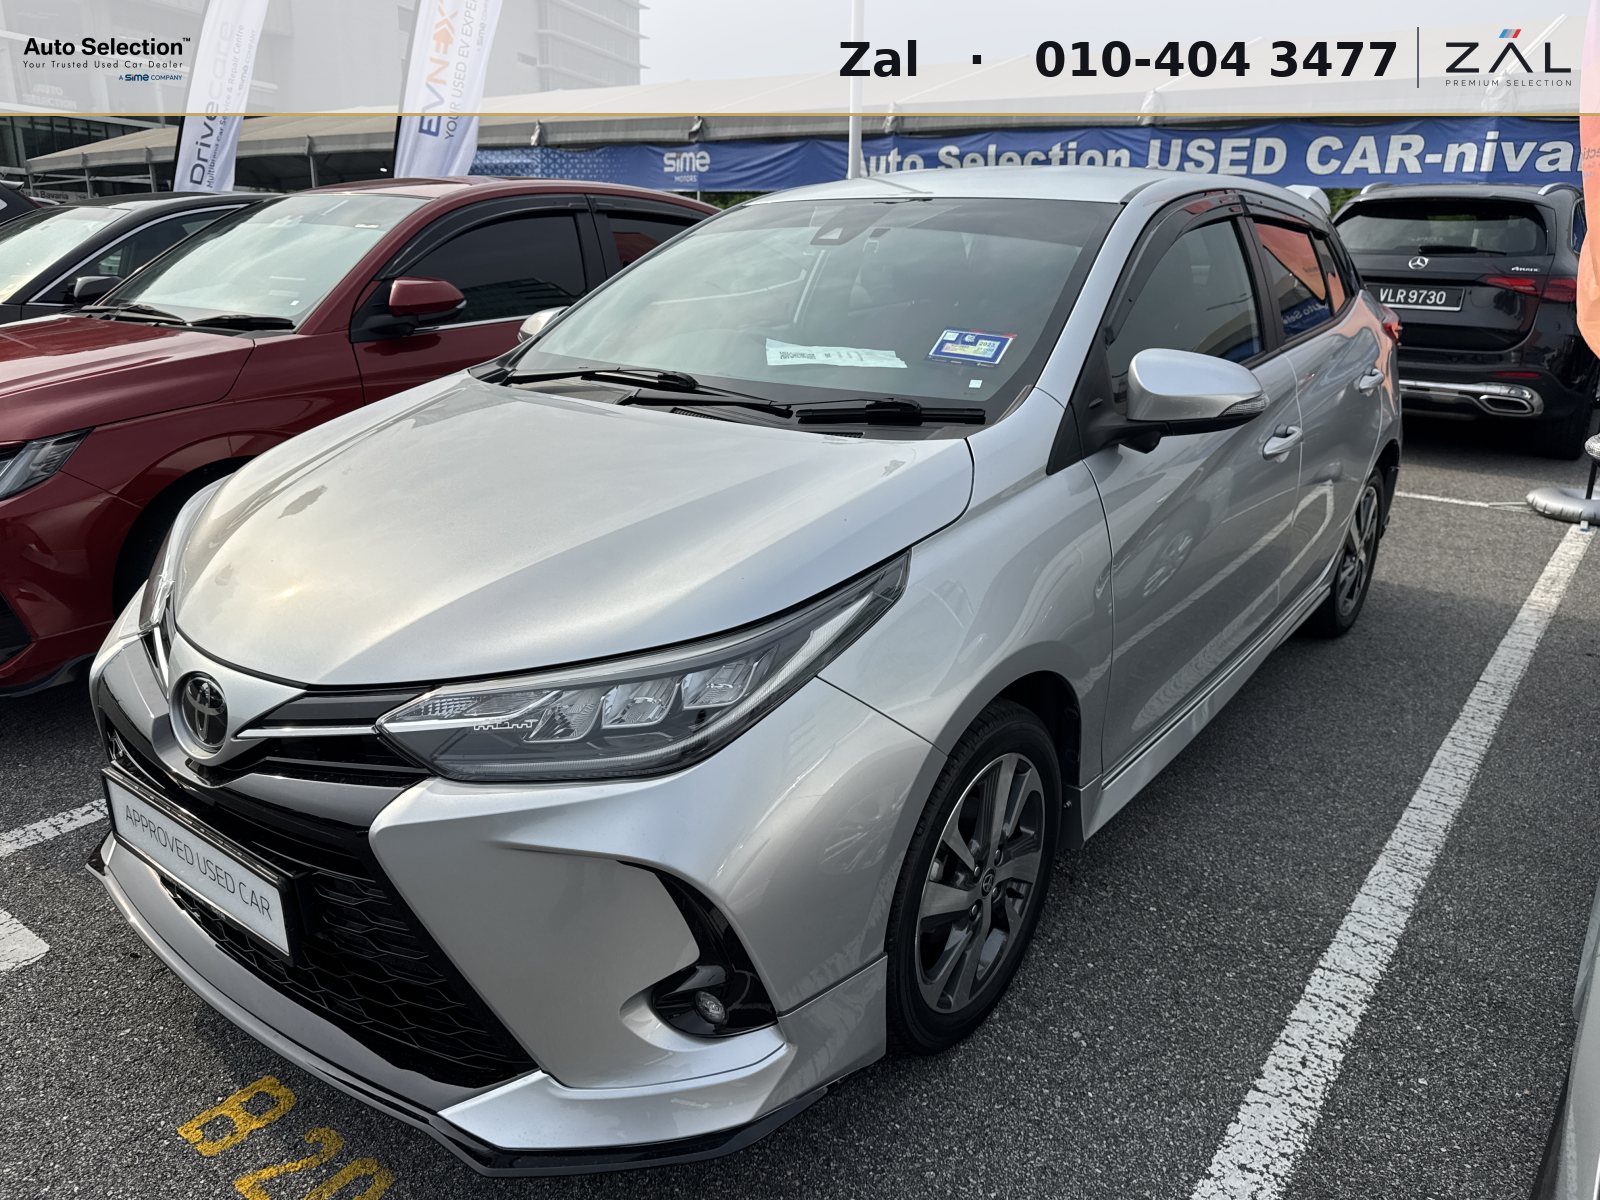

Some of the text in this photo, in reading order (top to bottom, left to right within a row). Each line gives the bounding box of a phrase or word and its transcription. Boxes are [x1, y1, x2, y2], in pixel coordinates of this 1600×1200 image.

[445, 0, 477, 140] YOUR USED EV EXPE
[663, 151, 711, 172] sime
[937, 142, 1131, 169] Selection
[1148, 137, 1287, 175] USED
[1305, 131, 1582, 175] CAR-niva
[125, 805, 273, 921] APPROVED USED CAR
[176, 1075, 298, 1157] B
